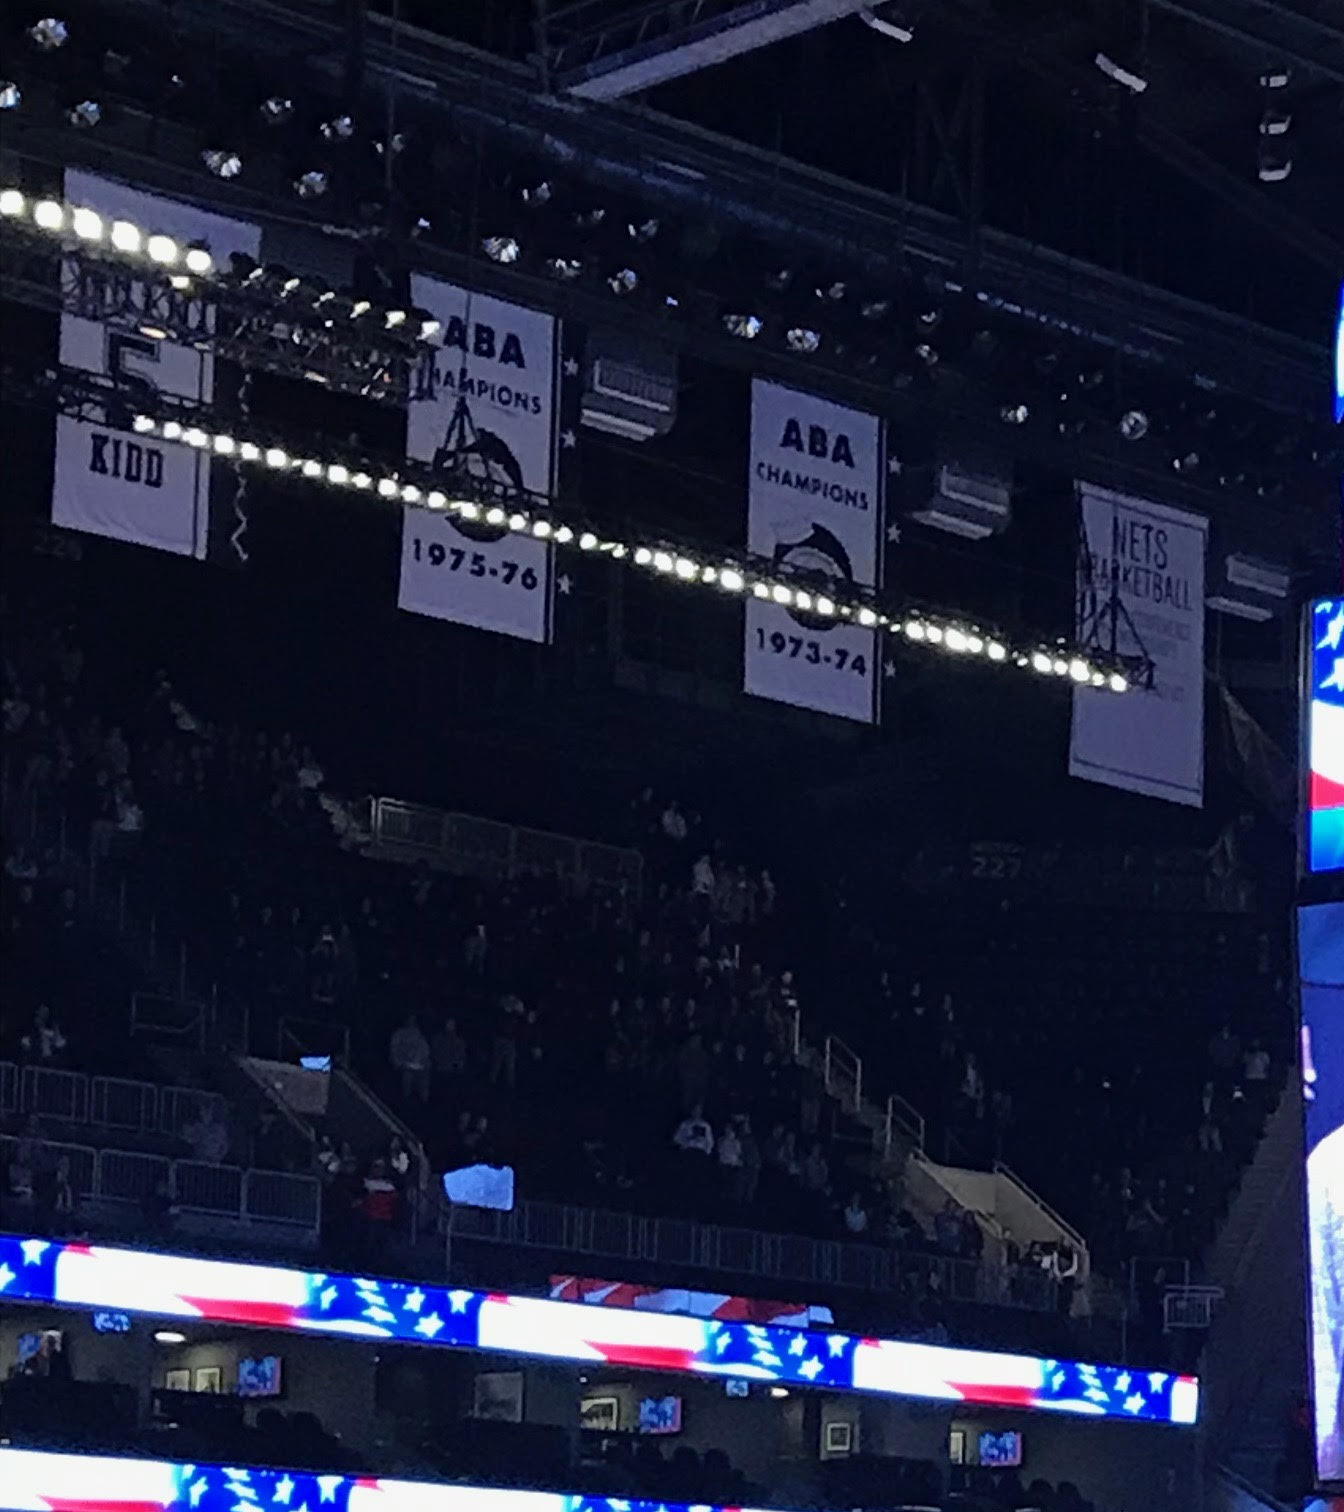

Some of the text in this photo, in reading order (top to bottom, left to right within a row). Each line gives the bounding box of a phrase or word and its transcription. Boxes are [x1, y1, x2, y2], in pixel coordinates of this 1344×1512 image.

[443, 316, 526, 370] ABA
[424, 363, 542, 416] HAMPIONS
[89, 432, 163, 488] KIDD
[779, 418, 856, 470] ABA
[757, 461, 869, 512] CHAMPIONS
[412, 539, 538, 591] 1975-76
[756, 628, 868, 678] 1973-74
